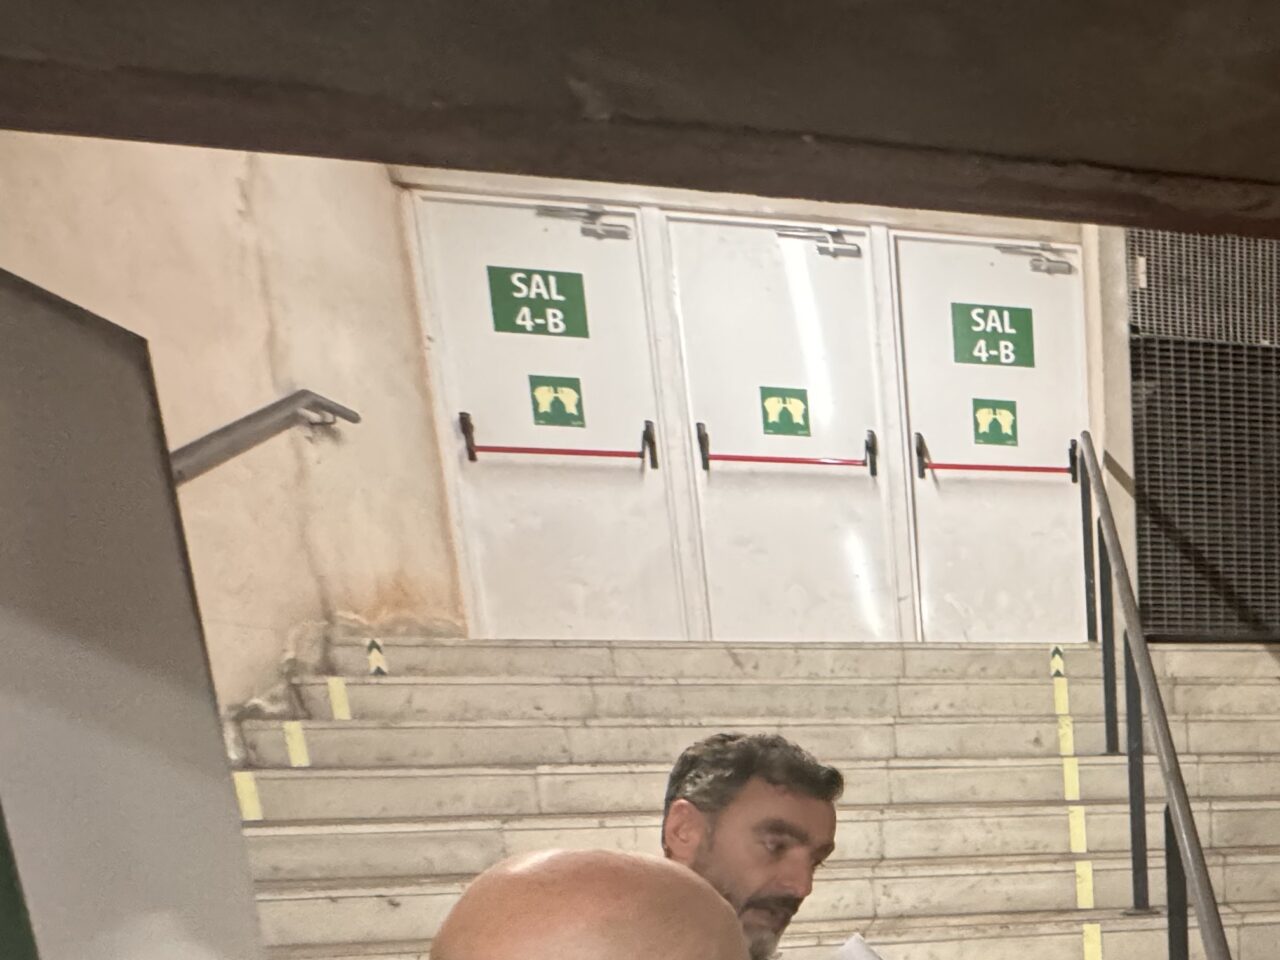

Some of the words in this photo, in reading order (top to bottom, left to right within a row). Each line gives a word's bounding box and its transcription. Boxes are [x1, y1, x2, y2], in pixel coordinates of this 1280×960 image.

[510, 272, 566, 301] SAL
[515, 306, 567, 333] 4-B
[970, 308, 1017, 334] SAL
[972, 339, 1016, 364] 4-B
